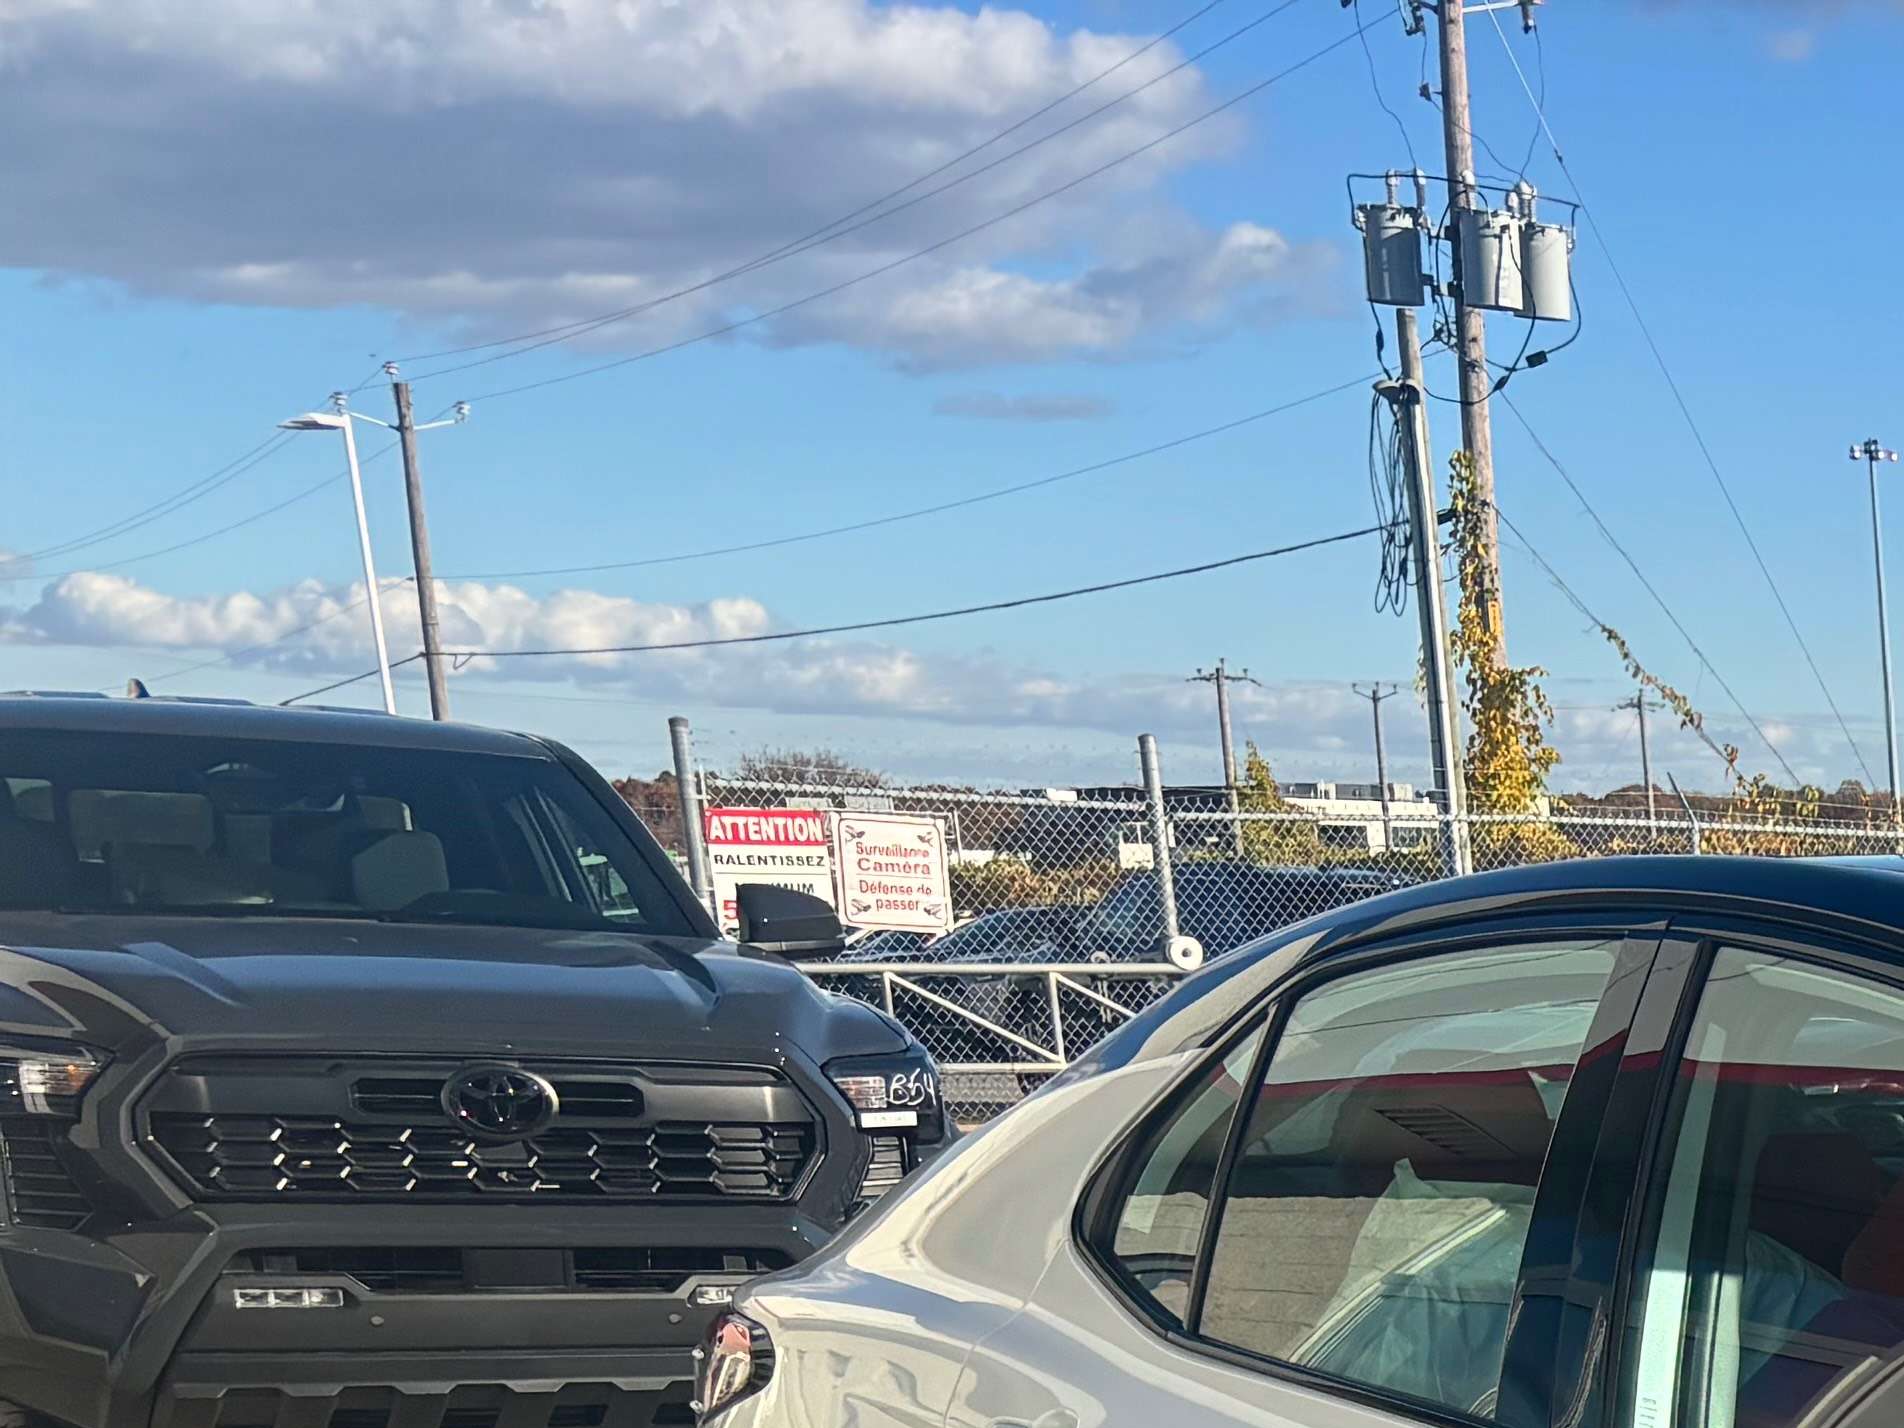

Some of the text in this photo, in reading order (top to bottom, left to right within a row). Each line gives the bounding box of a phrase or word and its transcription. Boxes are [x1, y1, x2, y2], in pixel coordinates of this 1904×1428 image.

[709, 815, 825, 842] ATTENTION
[855, 841, 930, 858] Surveillance
[714, 853, 825, 867] RALENTISSEZ
[859, 879, 932, 896] Défense de
[876, 898, 919, 912] passer
[886, 1067, 936, 1106] B54
